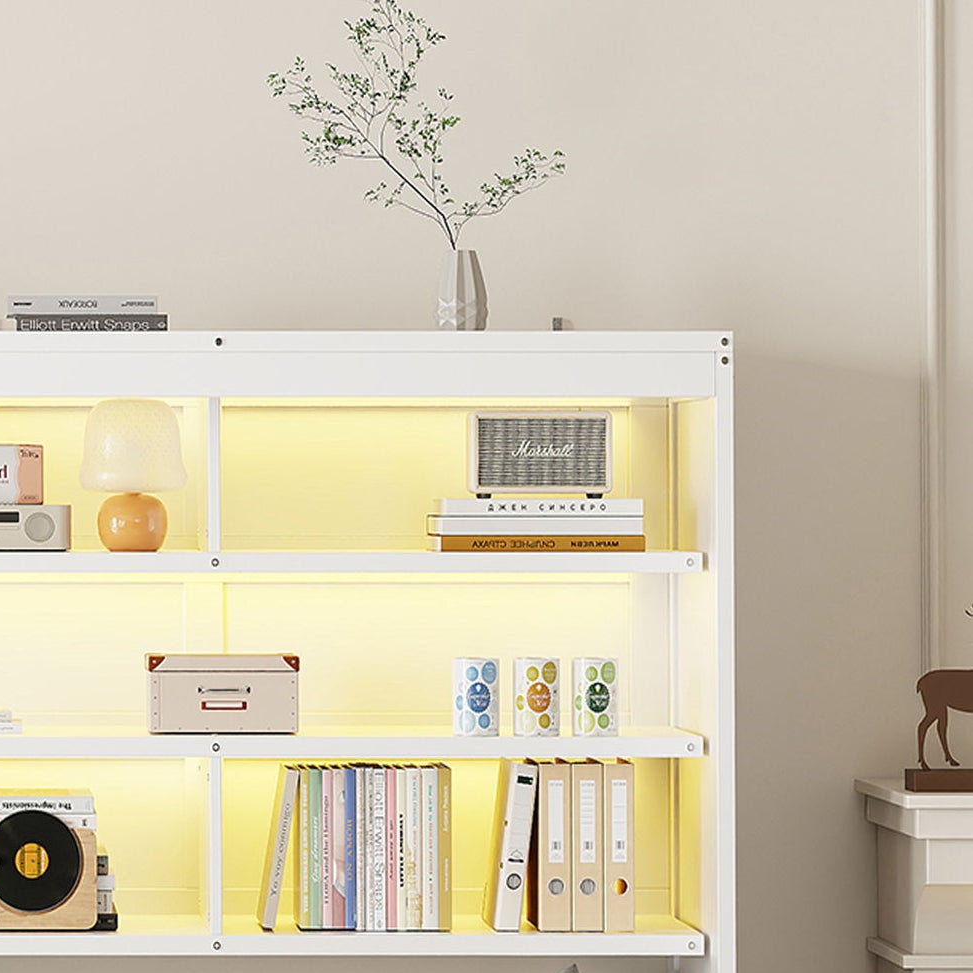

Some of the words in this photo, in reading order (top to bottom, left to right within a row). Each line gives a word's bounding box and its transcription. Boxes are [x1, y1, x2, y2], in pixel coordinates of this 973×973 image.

[20, 318, 56, 331] Elliott
[61, 318, 100, 331] Erwitt
[103, 318, 149, 331] Snaps
[511, 439, 575, 457] Marshall
[487, 503, 528, 512] ДЖЕН
[538, 503, 607, 512] СИНСЕРО
[375, 772, 384, 811] Elliott
[1, 800, 57, 811] Impressionists
[58, 802, 73, 810] The
[375, 816, 384, 857] Erwitt
[270, 881, 278, 896] Yo
[275, 856, 283, 877] voy
[375, 862, 384, 911] Snaps
